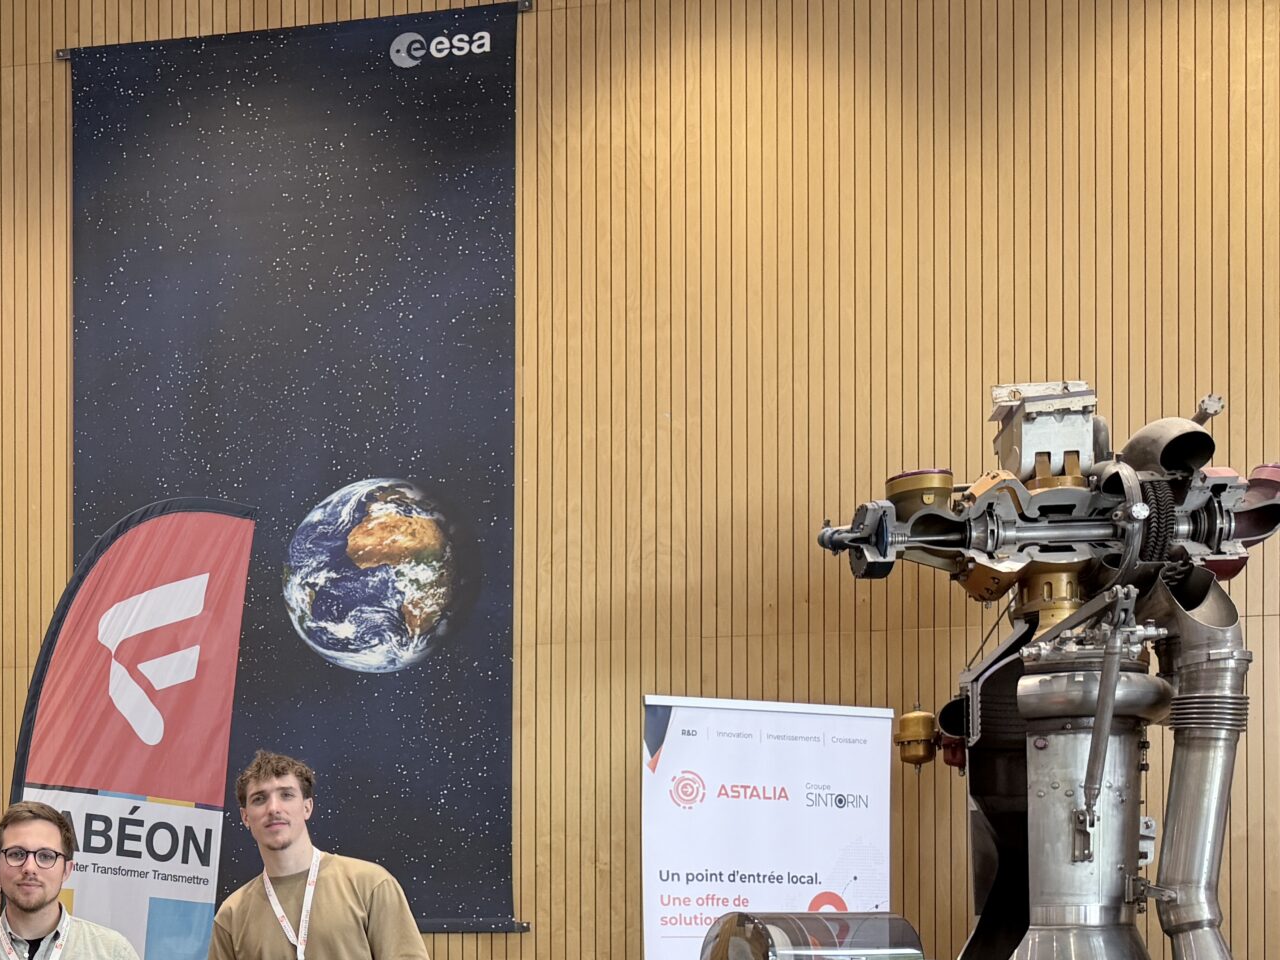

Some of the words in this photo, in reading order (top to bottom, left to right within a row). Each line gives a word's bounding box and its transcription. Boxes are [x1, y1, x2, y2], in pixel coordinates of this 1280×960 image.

[429, 31, 491, 59] esa
[681, 729, 697, 737] R&D
[716, 730, 753, 739] Innovation
[766, 732, 821, 743] Investissements
[831, 735, 868, 745] Croissance
[716, 783, 789, 801] ASTALIA
[805, 782, 831, 791] Groupe
[805, 792, 869, 809] SINTORIN
[90, 863, 150, 879] Transformer
[152, 869, 210, 886] Transmettre
[658, 869, 681, 883] Un
[685, 868, 724, 885] point
[727, 870, 784, 884] d'entrée
[787, 871, 822, 885] local.
[660, 894, 692, 907] Une
[695, 894, 730, 907] offre
[732, 894, 750, 908] de
